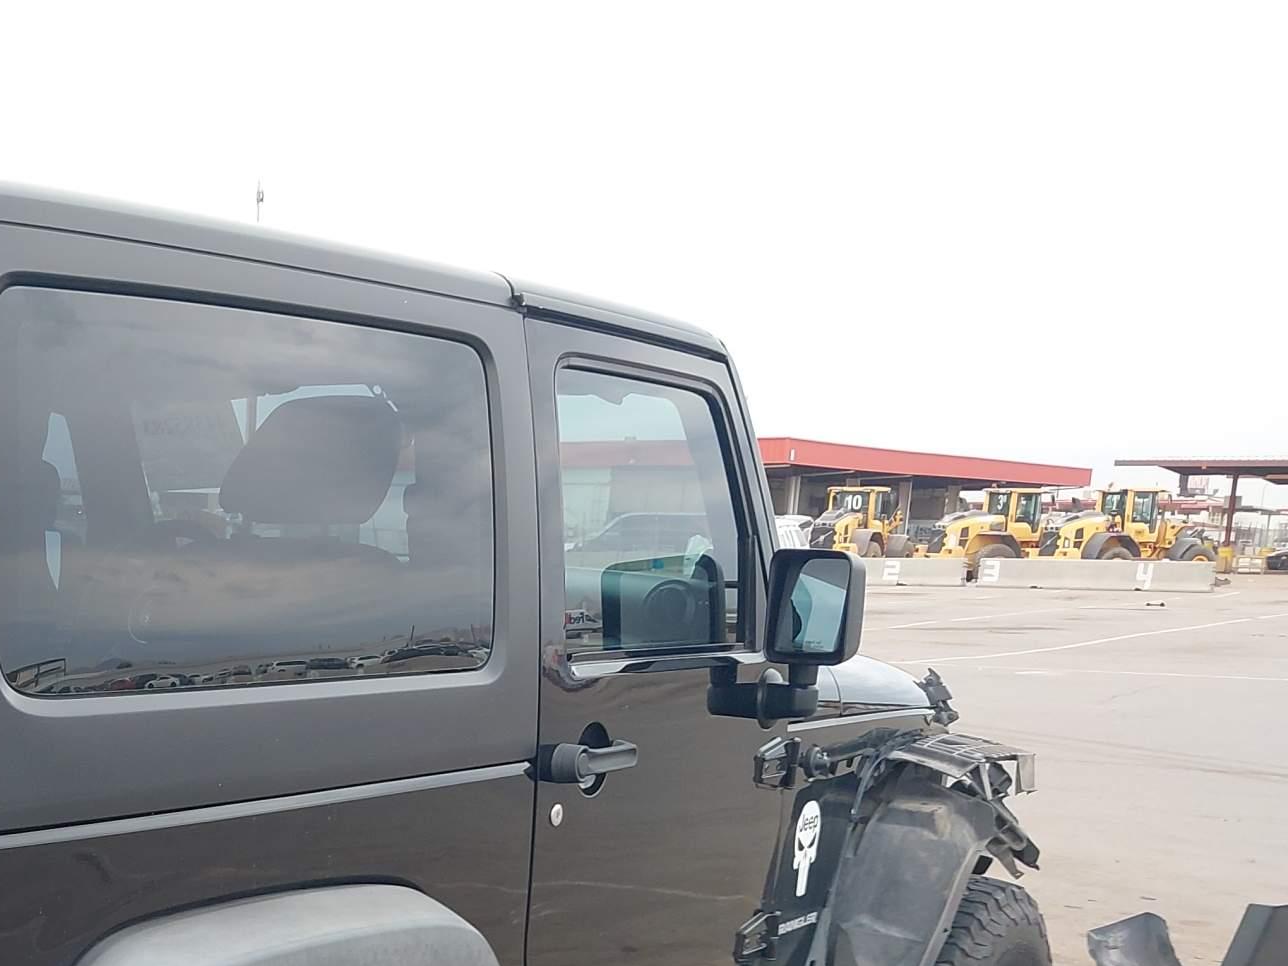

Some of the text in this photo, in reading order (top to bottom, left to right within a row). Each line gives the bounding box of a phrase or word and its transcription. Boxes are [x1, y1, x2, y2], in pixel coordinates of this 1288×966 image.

[882, 560, 901, 581] 2
[983, 560, 1001, 582] 3
[1135, 563, 1155, 590] 4
[798, 813, 818, 832] Jeep
